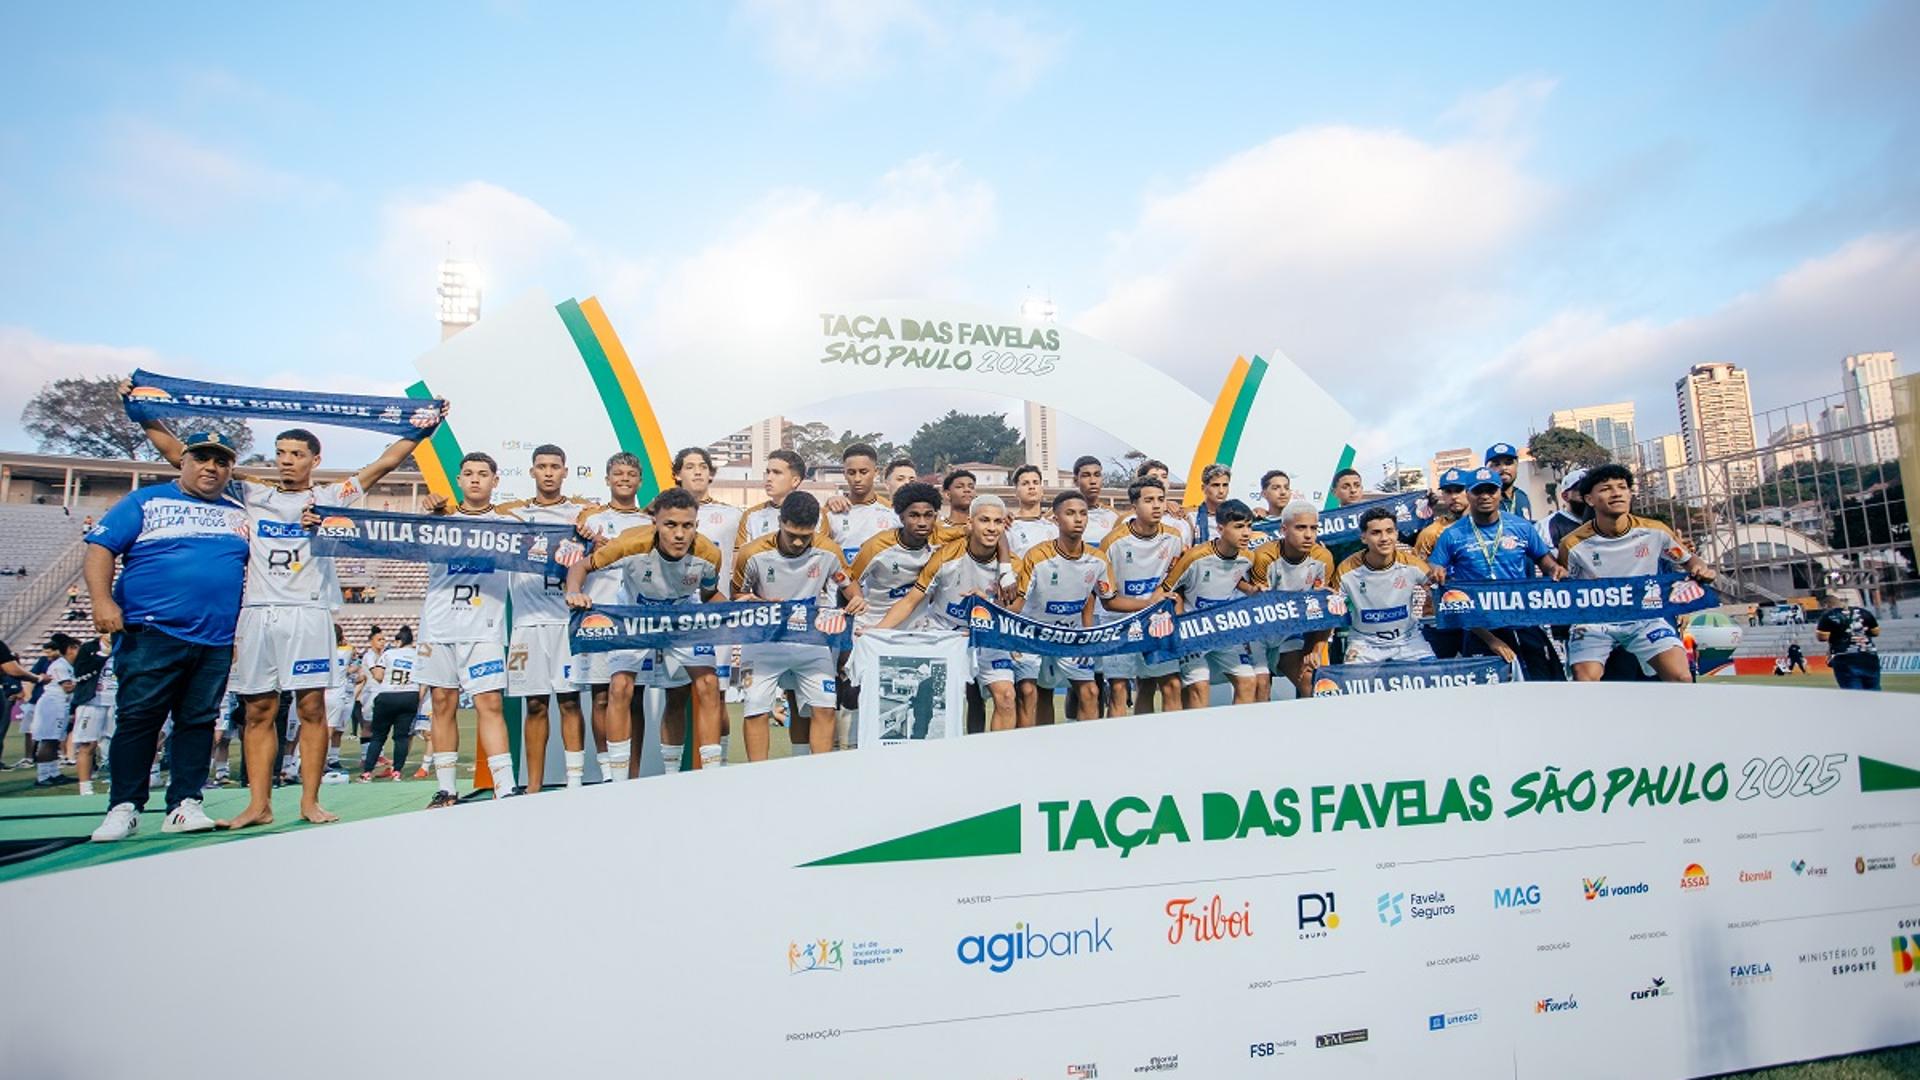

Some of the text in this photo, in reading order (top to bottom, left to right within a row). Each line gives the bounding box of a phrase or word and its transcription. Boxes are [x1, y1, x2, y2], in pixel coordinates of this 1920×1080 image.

[820, 313, 1061, 351] TAÇA DAS FAVELAS
[820, 340, 1061, 376] SÃO PAULO 2025
[364, 519, 414, 544] VILA
[453, 584, 480, 605] R1
[1478, 590, 1529, 611] VILA
[1575, 584, 1634, 608] JOSÉ
[1365, 605, 1408, 622] agibank
[623, 614, 674, 636] VILA
[998, 614, 1035, 640] VILA
[1179, 616, 1216, 640] VILA
[508, 651, 528, 671] 27
[1344, 678, 1386, 697] VILA
[1038, 753, 1848, 858] TAÇA DAS FAVELAS SÃO PAULO 2025
[1410, 890, 1446, 905] Favela
[1494, 884, 1542, 910] MAG
[1611, 882, 1649, 897] voando
[957, 895, 992, 905] MASTER
[1166, 895, 1253, 945] Friboi
[1298, 892, 1335, 931] R1
[1411, 904, 1456, 920] Seguros
[957, 917, 1113, 974] agibank
[1799, 946, 1876, 964] MINISTÉRIO DO
[853, 957, 886, 966] Esporte
[1730, 963, 1772, 978] FAVELA
[1832, 961, 1877, 976] ESPORTE
[1447, 1012, 1479, 1026] unesco
[786, 1029, 841, 1042] PROMOÇÃO
[1250, 1042, 1275, 1058] FSB
